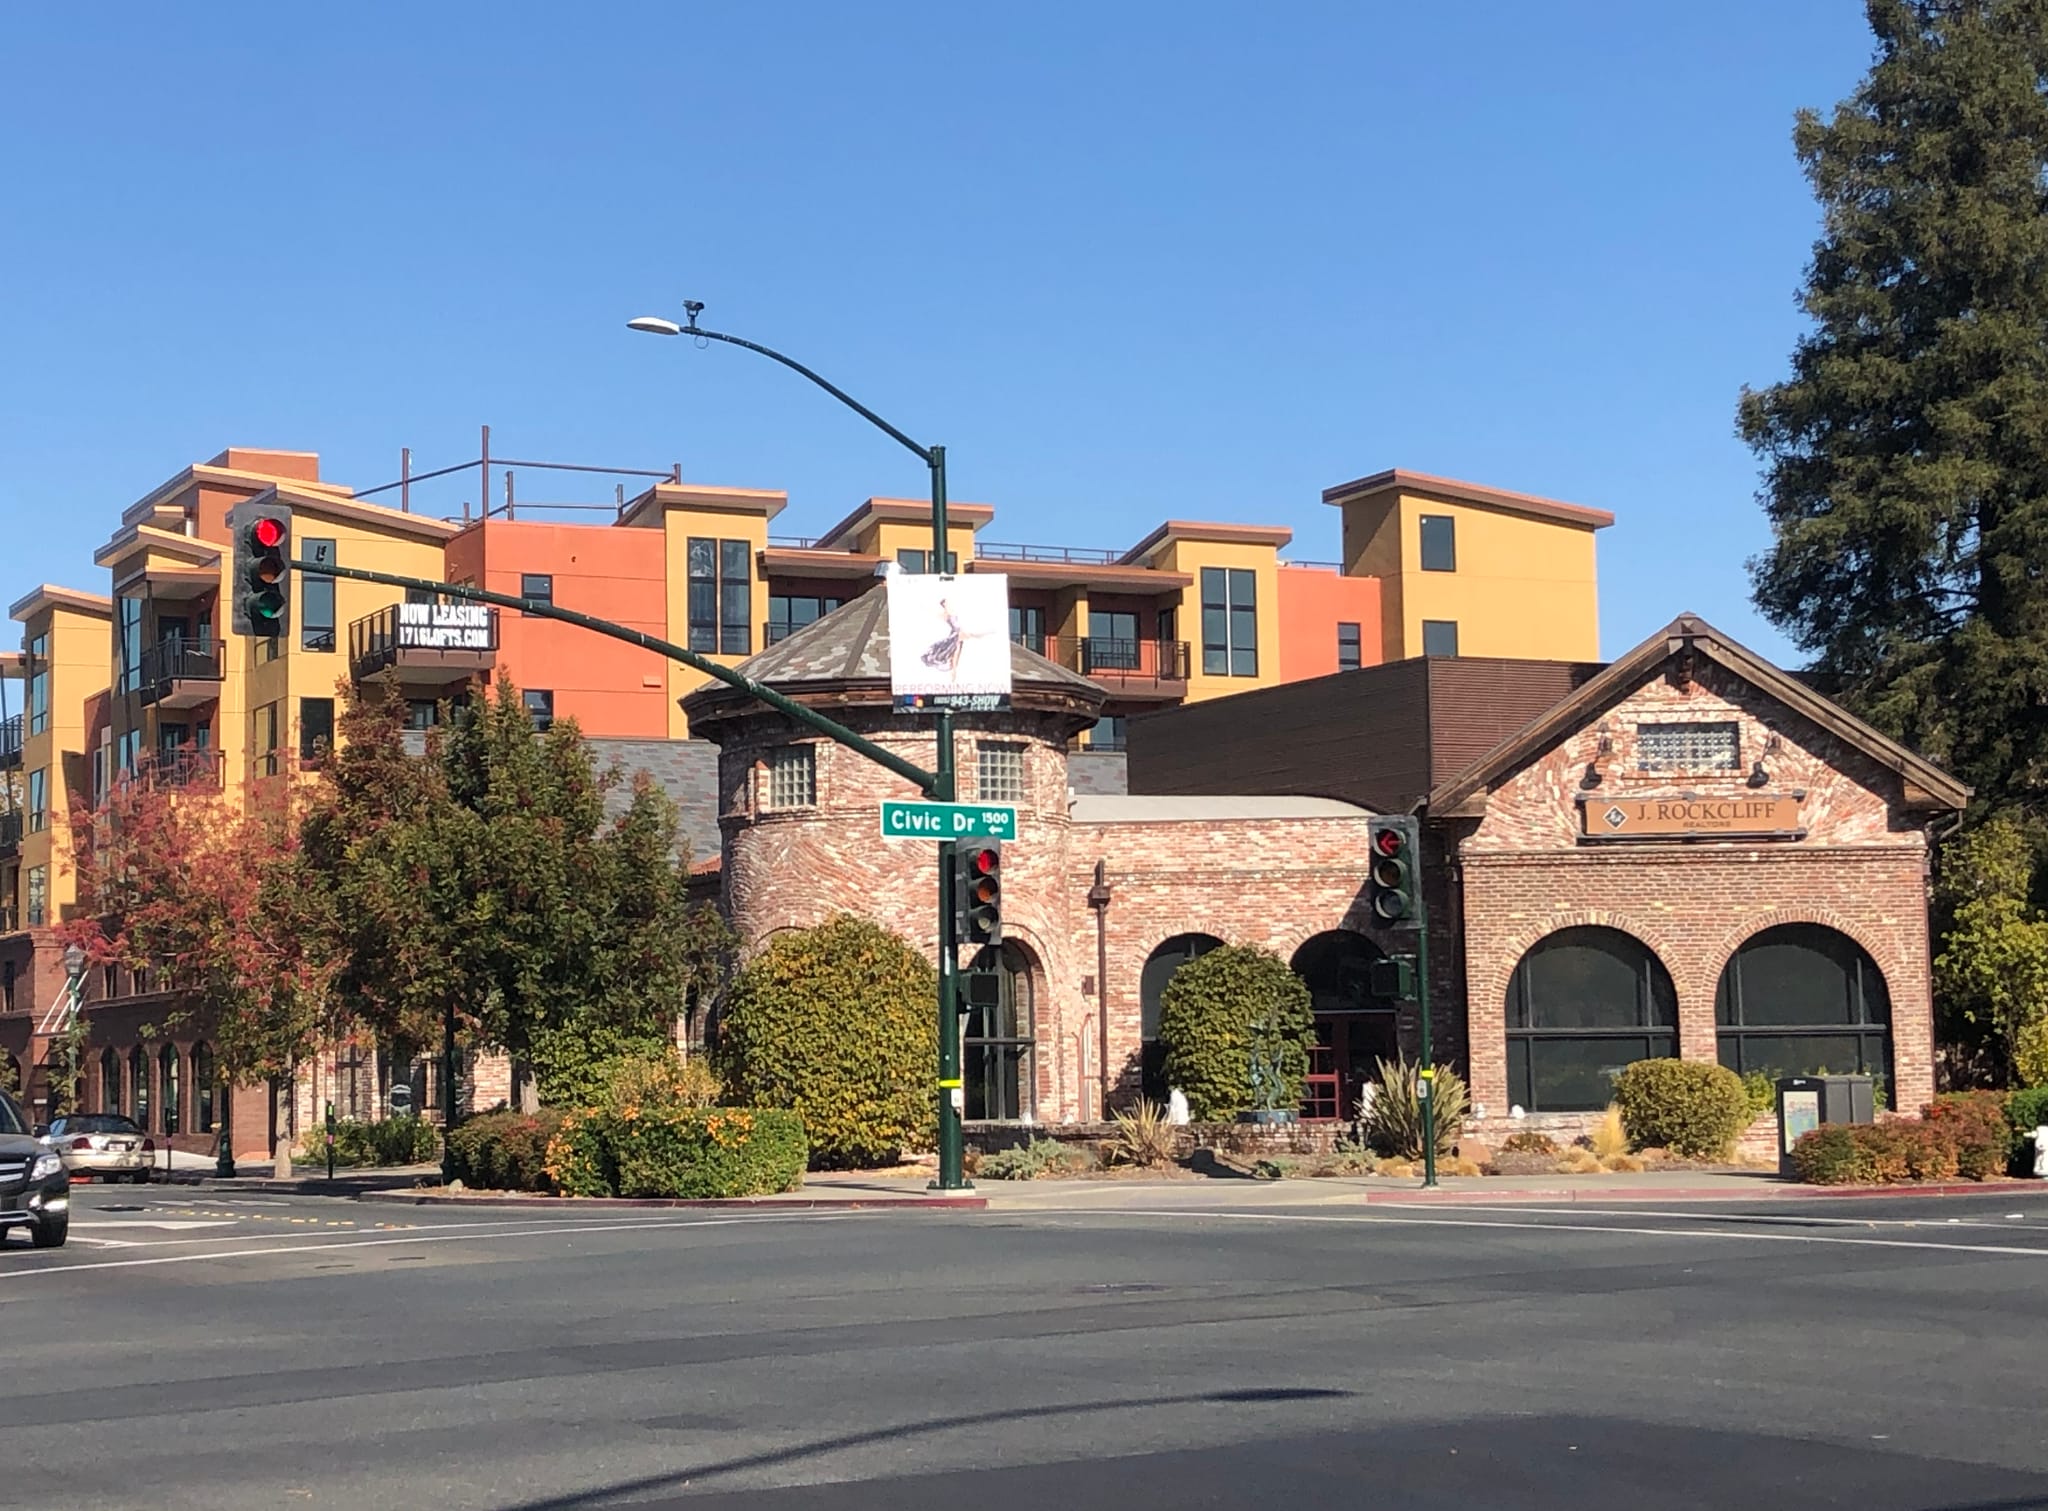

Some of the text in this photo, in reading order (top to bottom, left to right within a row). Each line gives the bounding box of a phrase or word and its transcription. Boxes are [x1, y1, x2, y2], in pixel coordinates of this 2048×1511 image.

[399, 603, 488, 627] NOW LEASING
[399, 627, 489, 647] 1716LOFTS.COM
[895, 683, 973, 694] PERFORMING
[891, 809, 976, 832] Civic Dr
[981, 812, 1009, 825] 1500
[1637, 802, 1776, 821] J. ROCKCLIFF
